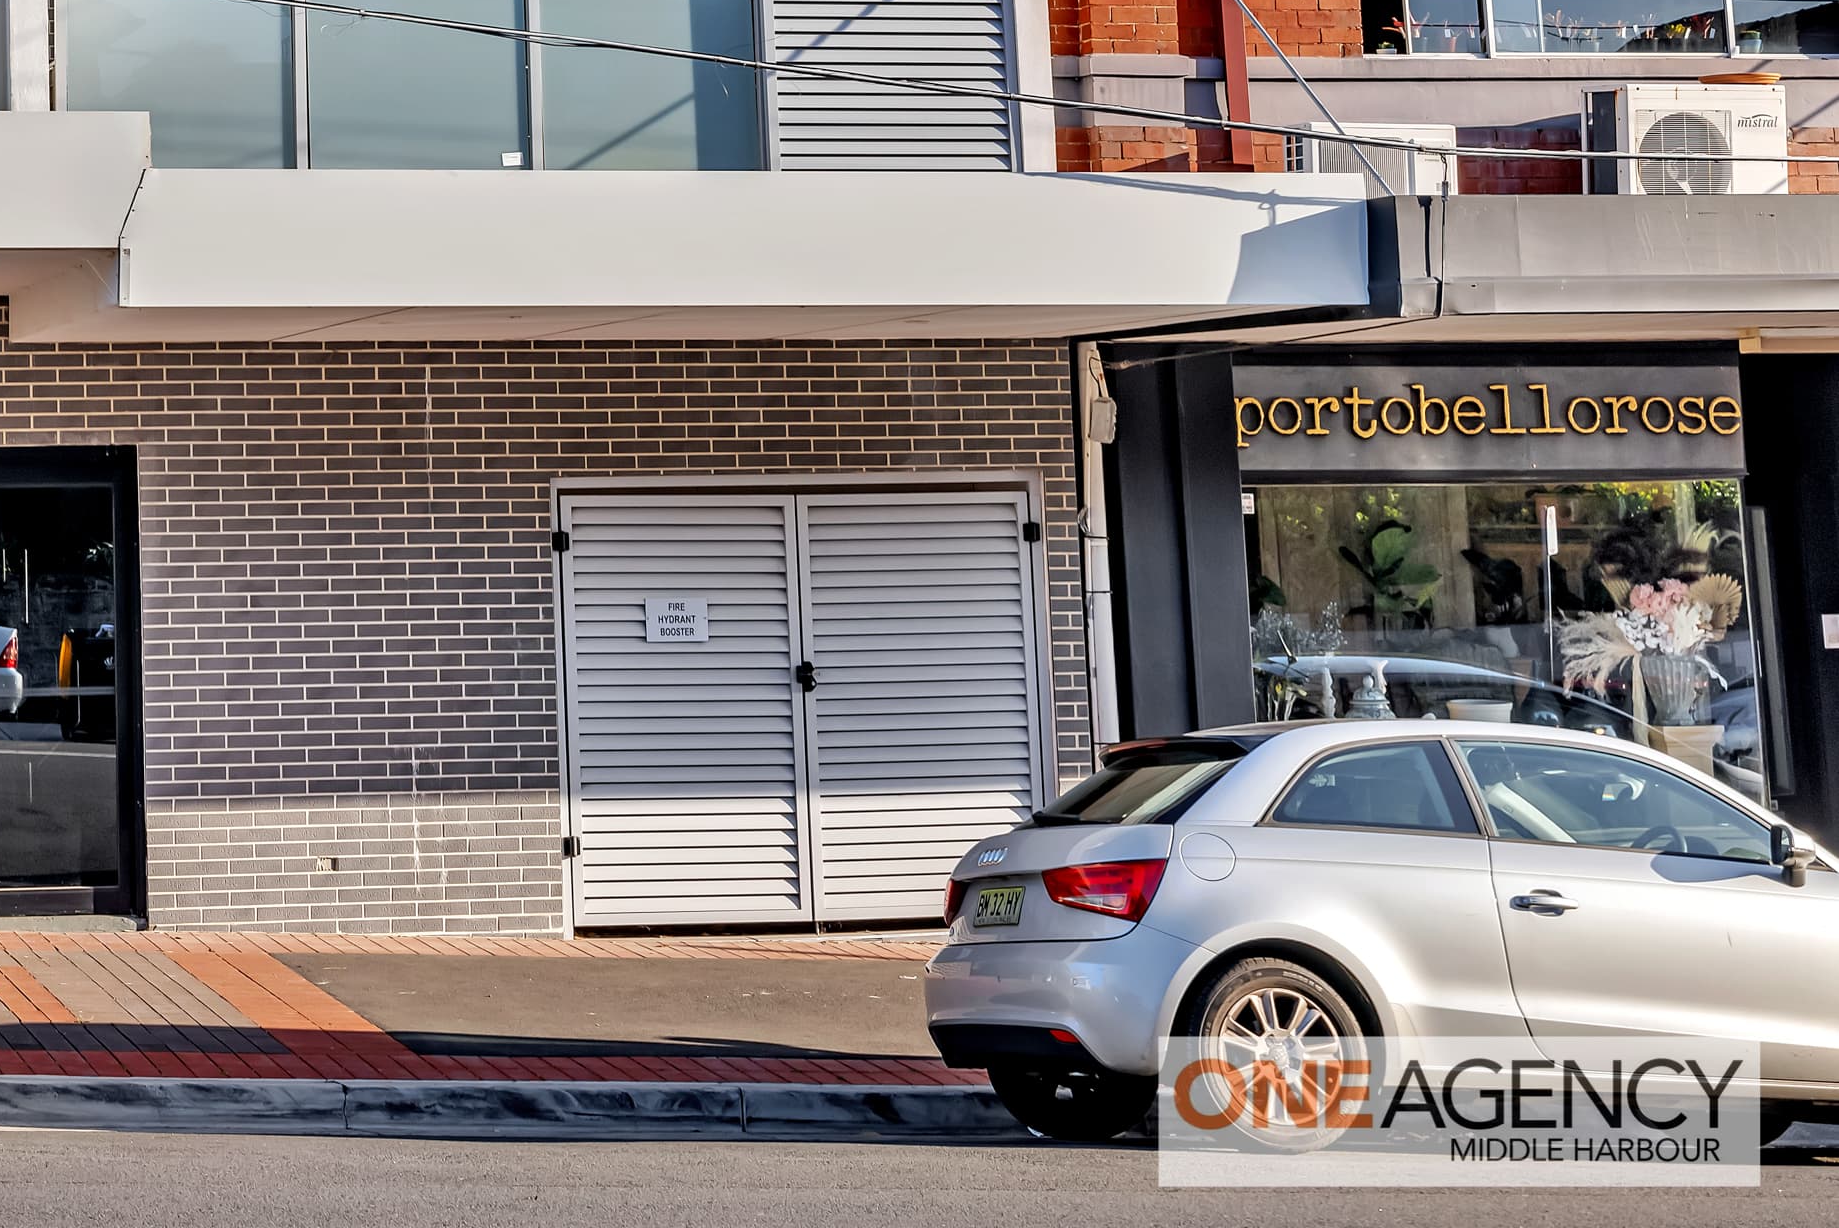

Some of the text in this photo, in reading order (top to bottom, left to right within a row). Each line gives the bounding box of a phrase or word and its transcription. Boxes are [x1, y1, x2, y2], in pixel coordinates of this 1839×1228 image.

[1737, 115, 1778, 128] mistral
[1234, 383, 1742, 448] portobellorose
[668, 602, 686, 612] FIRE
[658, 615, 696, 625] HYDRANT
[660, 627, 695, 637] BOOSTER
